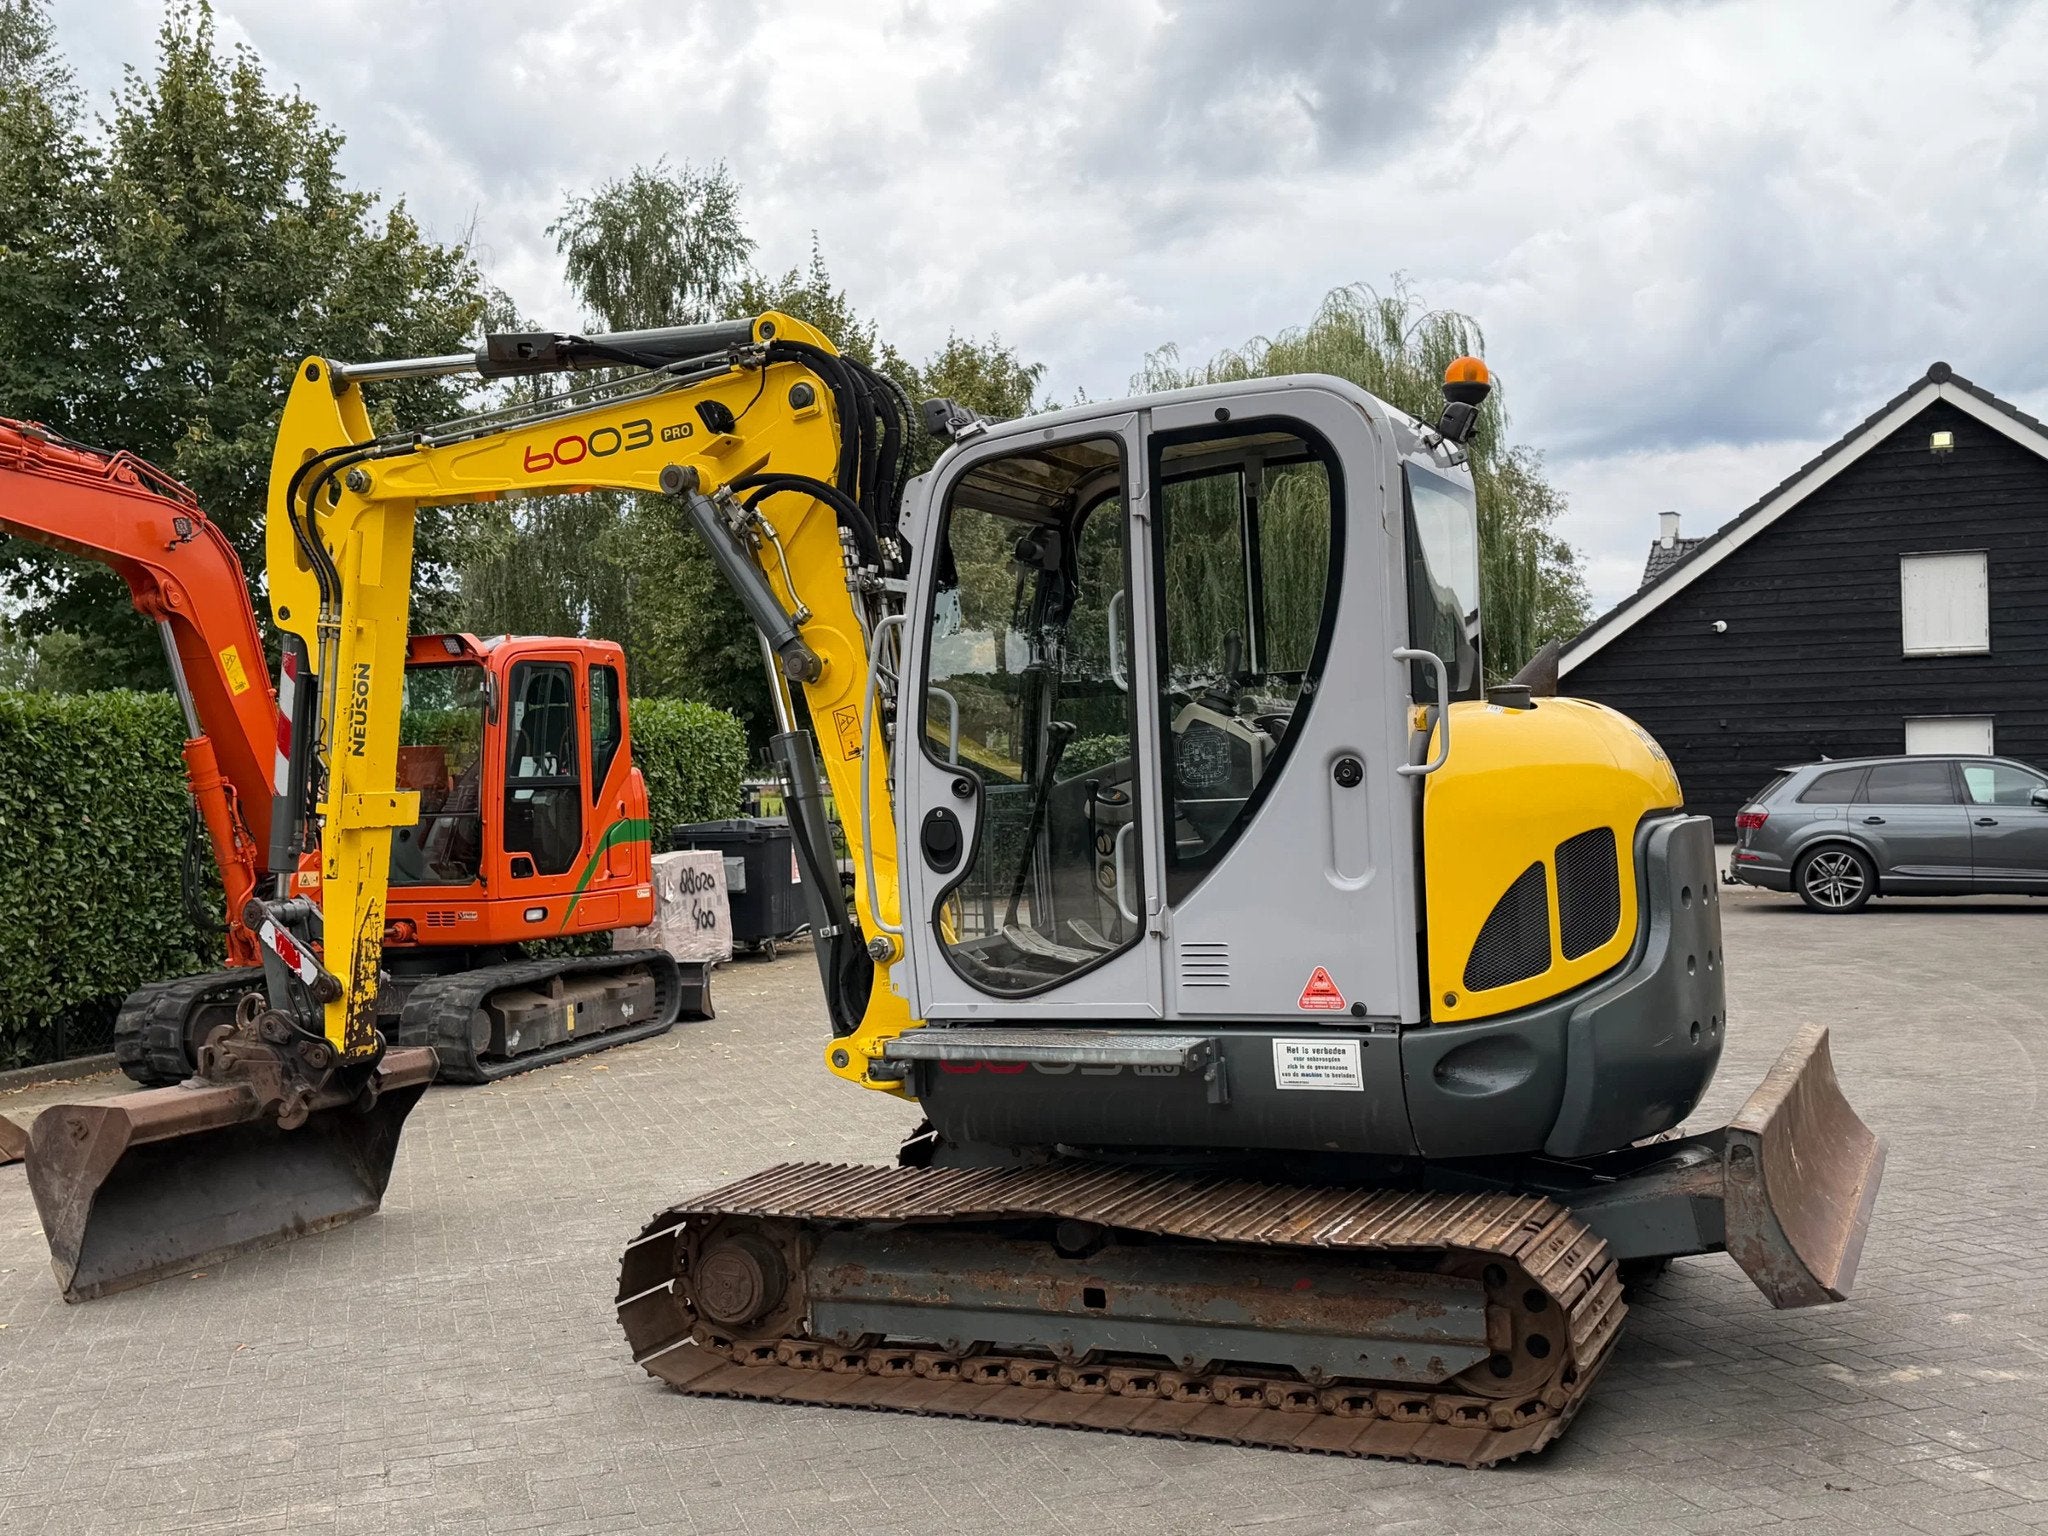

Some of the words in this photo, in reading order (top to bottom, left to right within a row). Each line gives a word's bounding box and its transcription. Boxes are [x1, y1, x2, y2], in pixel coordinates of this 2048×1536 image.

[523, 418, 654, 474] 6003
[662, 424, 691, 441] PRO
[352, 663, 371, 757] NEUSON
[679, 866, 715, 895] 88020
[692, 900, 716, 930] 400
[1287, 1046, 1299, 1054] Het
[1312, 1047, 1346, 1055] verboden
